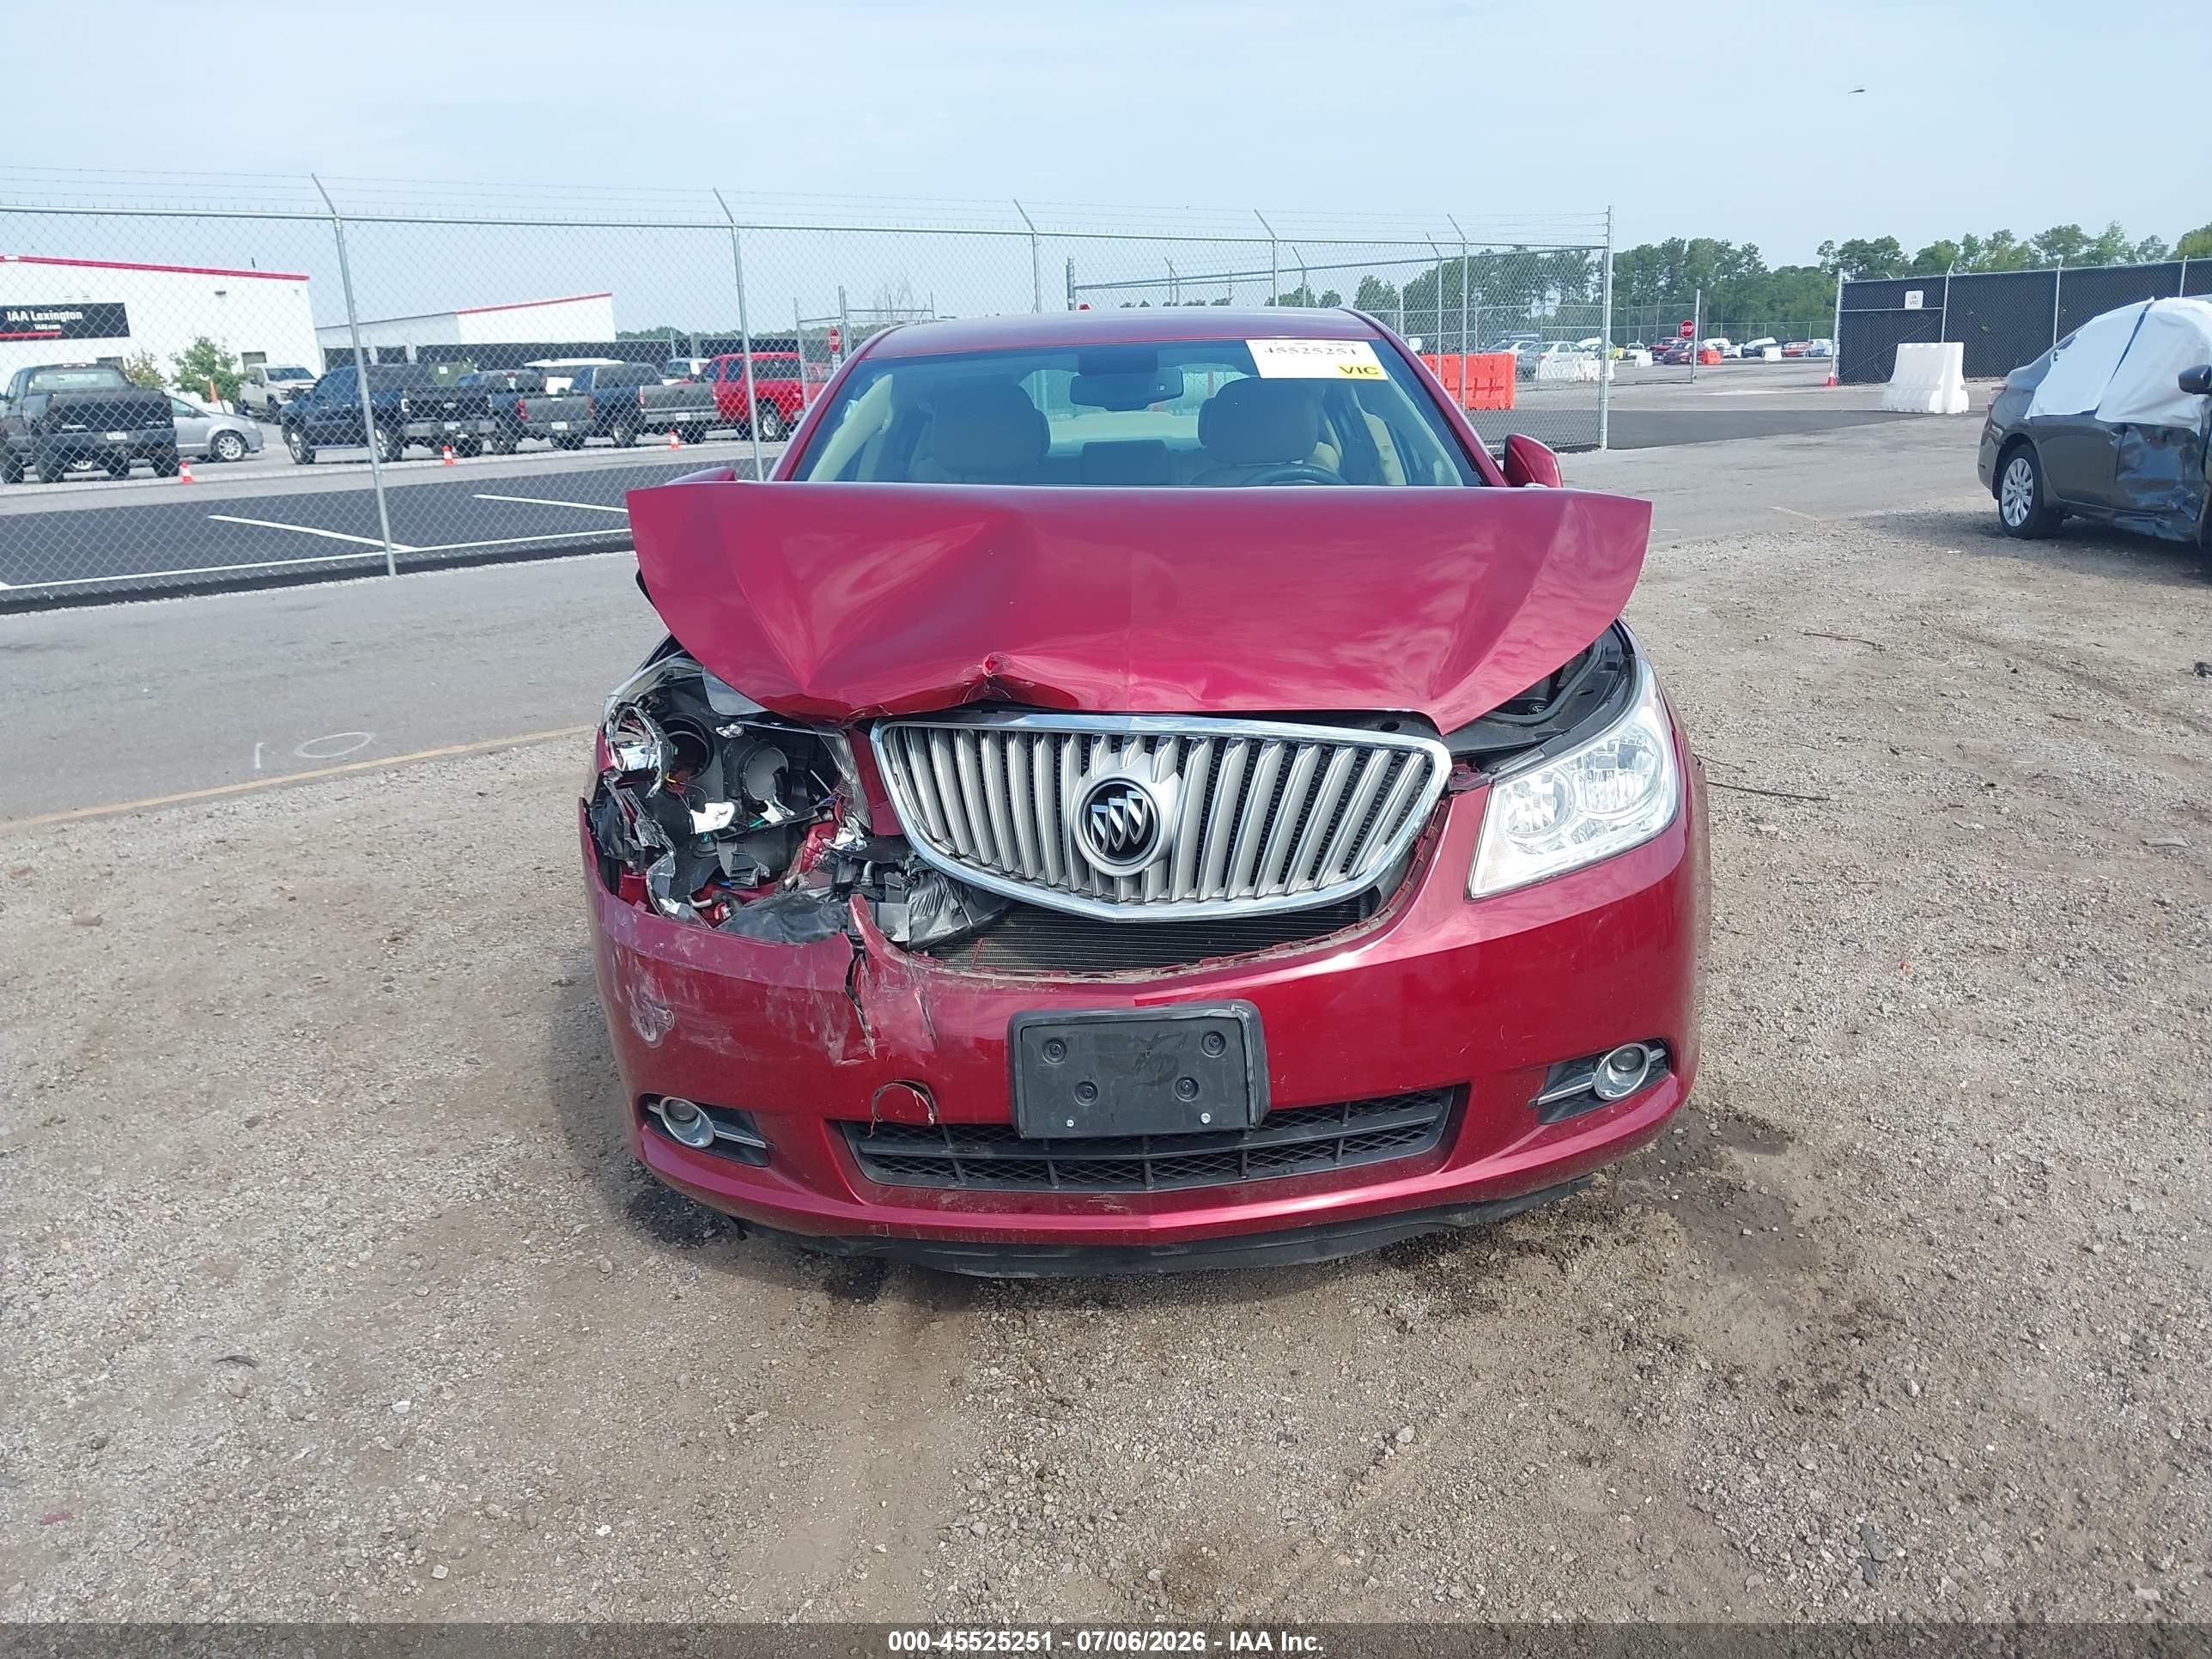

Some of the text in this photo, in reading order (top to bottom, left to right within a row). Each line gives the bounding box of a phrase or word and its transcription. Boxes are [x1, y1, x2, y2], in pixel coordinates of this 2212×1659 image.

[6, 309, 83, 323] IAA Lexington
[1264, 347, 1358, 356] 45525251
[1339, 365, 1379, 375] VIC
